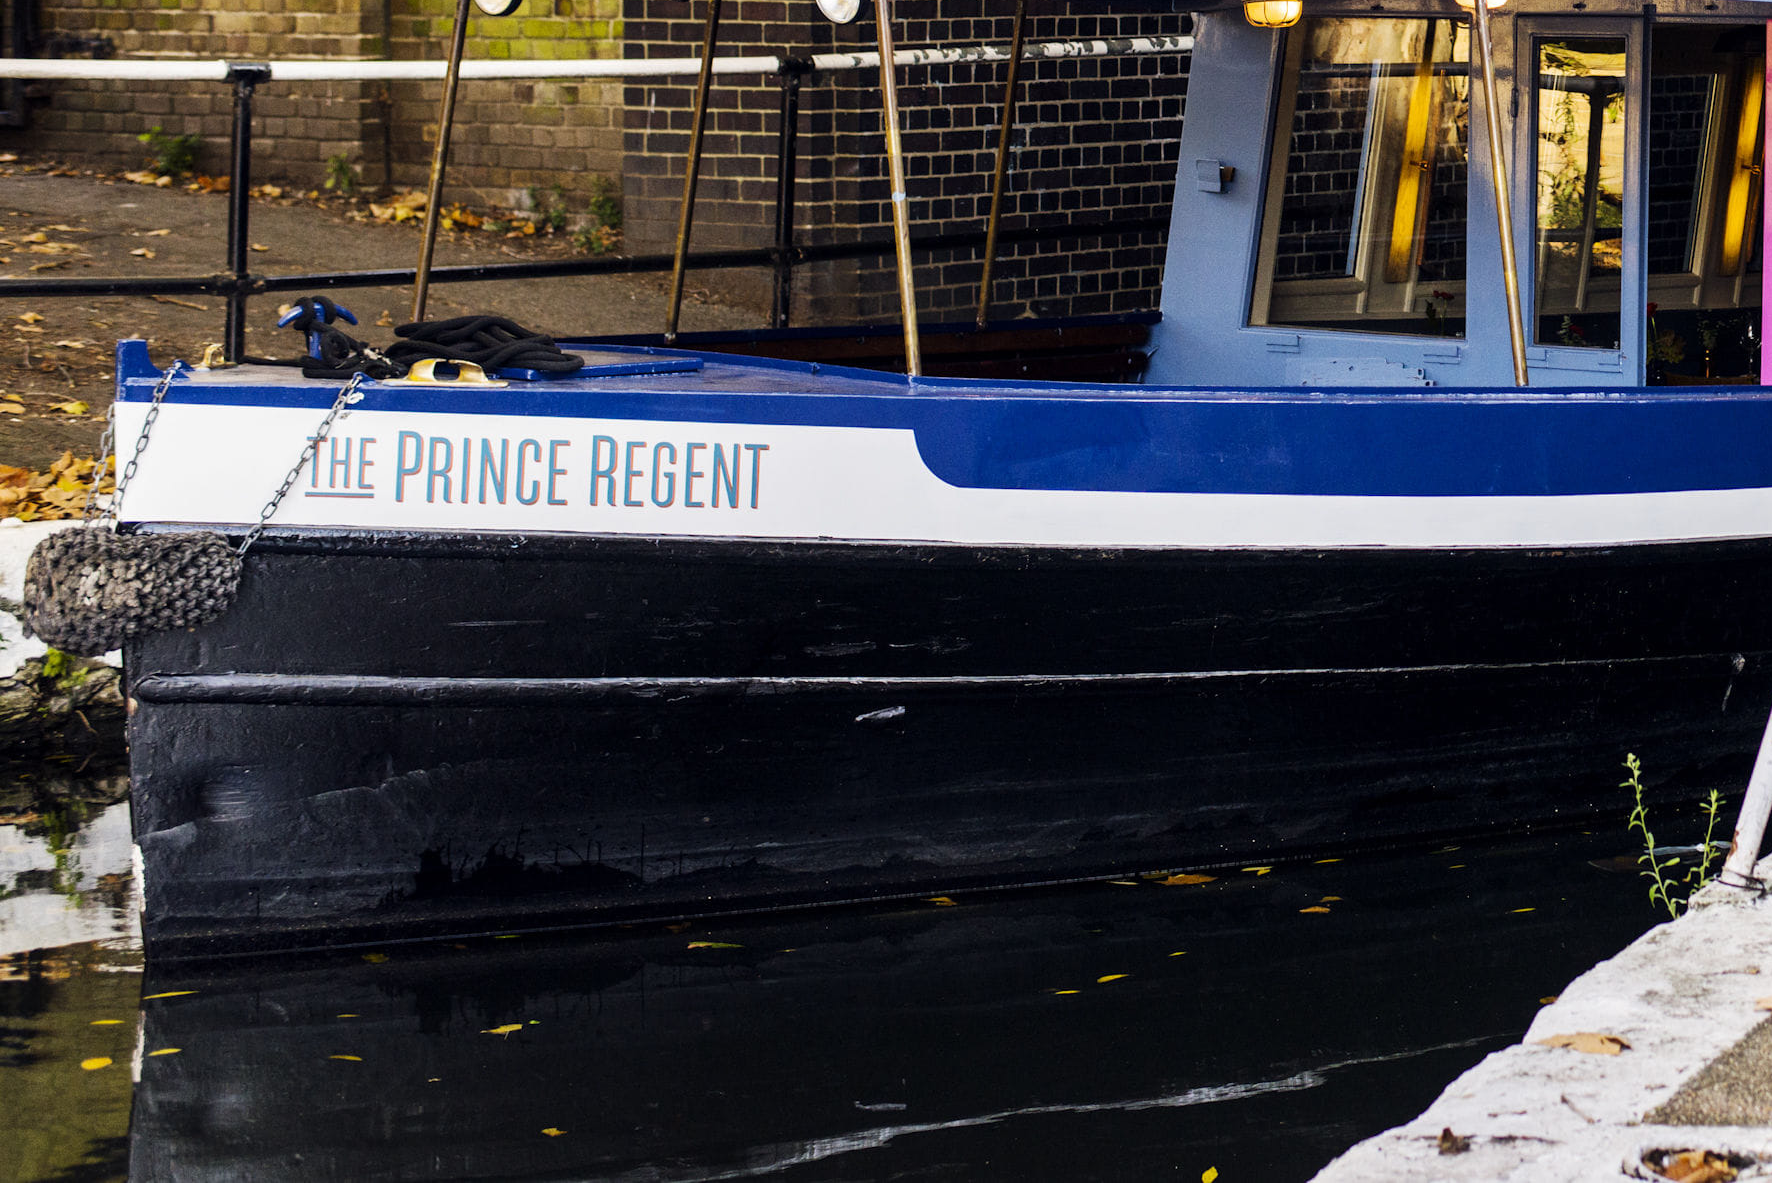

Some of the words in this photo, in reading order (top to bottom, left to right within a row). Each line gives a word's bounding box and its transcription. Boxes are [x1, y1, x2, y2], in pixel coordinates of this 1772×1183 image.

[306, 436, 377, 490] THE
[395, 430, 571, 506] PRINCE
[589, 434, 770, 509] REGENT
